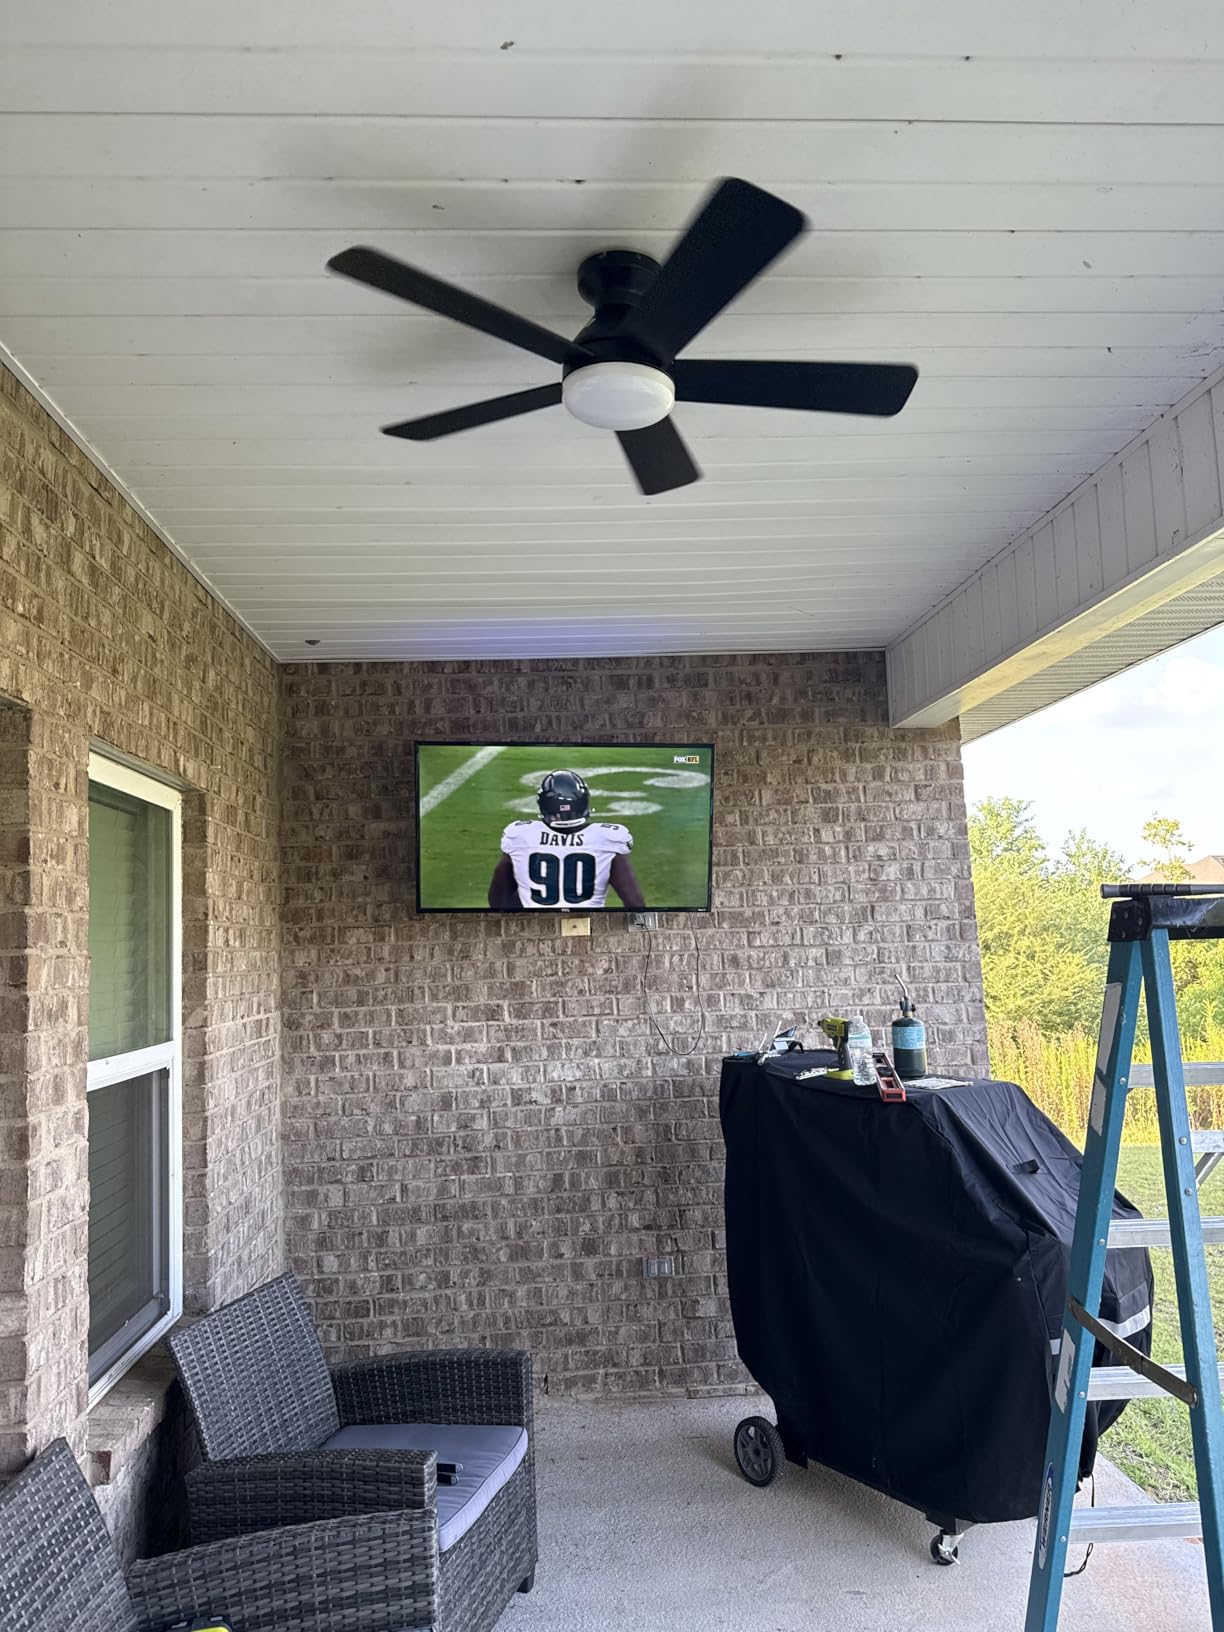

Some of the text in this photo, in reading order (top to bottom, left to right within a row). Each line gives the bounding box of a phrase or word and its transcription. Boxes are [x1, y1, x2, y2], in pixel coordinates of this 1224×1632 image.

[674, 756, 699, 764] FOX NFL
[540, 831, 584, 846] DAVIS
[529, 852, 596, 906] 90
